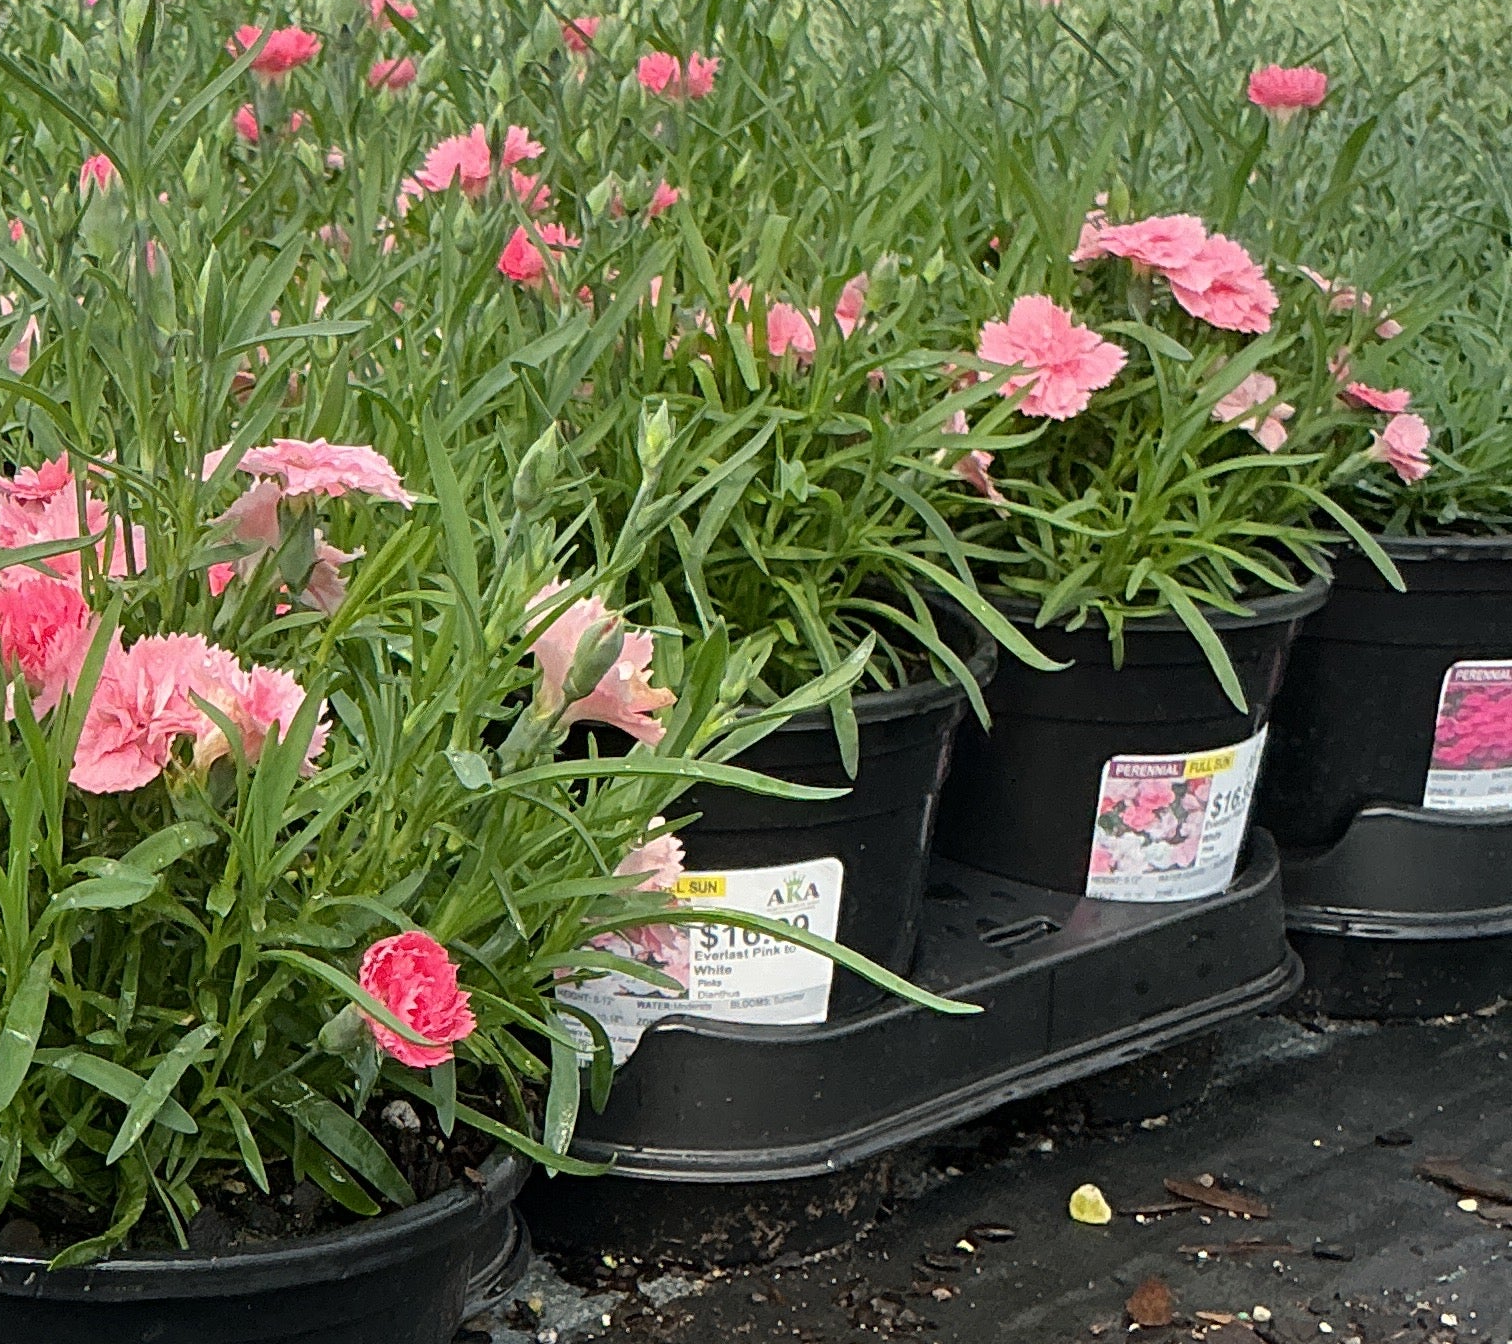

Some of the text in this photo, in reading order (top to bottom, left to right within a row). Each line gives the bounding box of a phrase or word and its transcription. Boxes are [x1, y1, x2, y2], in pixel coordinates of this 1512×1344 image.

[1115, 762, 1179, 776] PERENNIAL
[1189, 758, 1213, 773] FULL
[688, 880, 718, 894] SUN
[766, 882, 820, 907] AKA
[694, 949, 749, 961] Everlast
[752, 945, 781, 957] Pink
[694, 965, 733, 976] White
